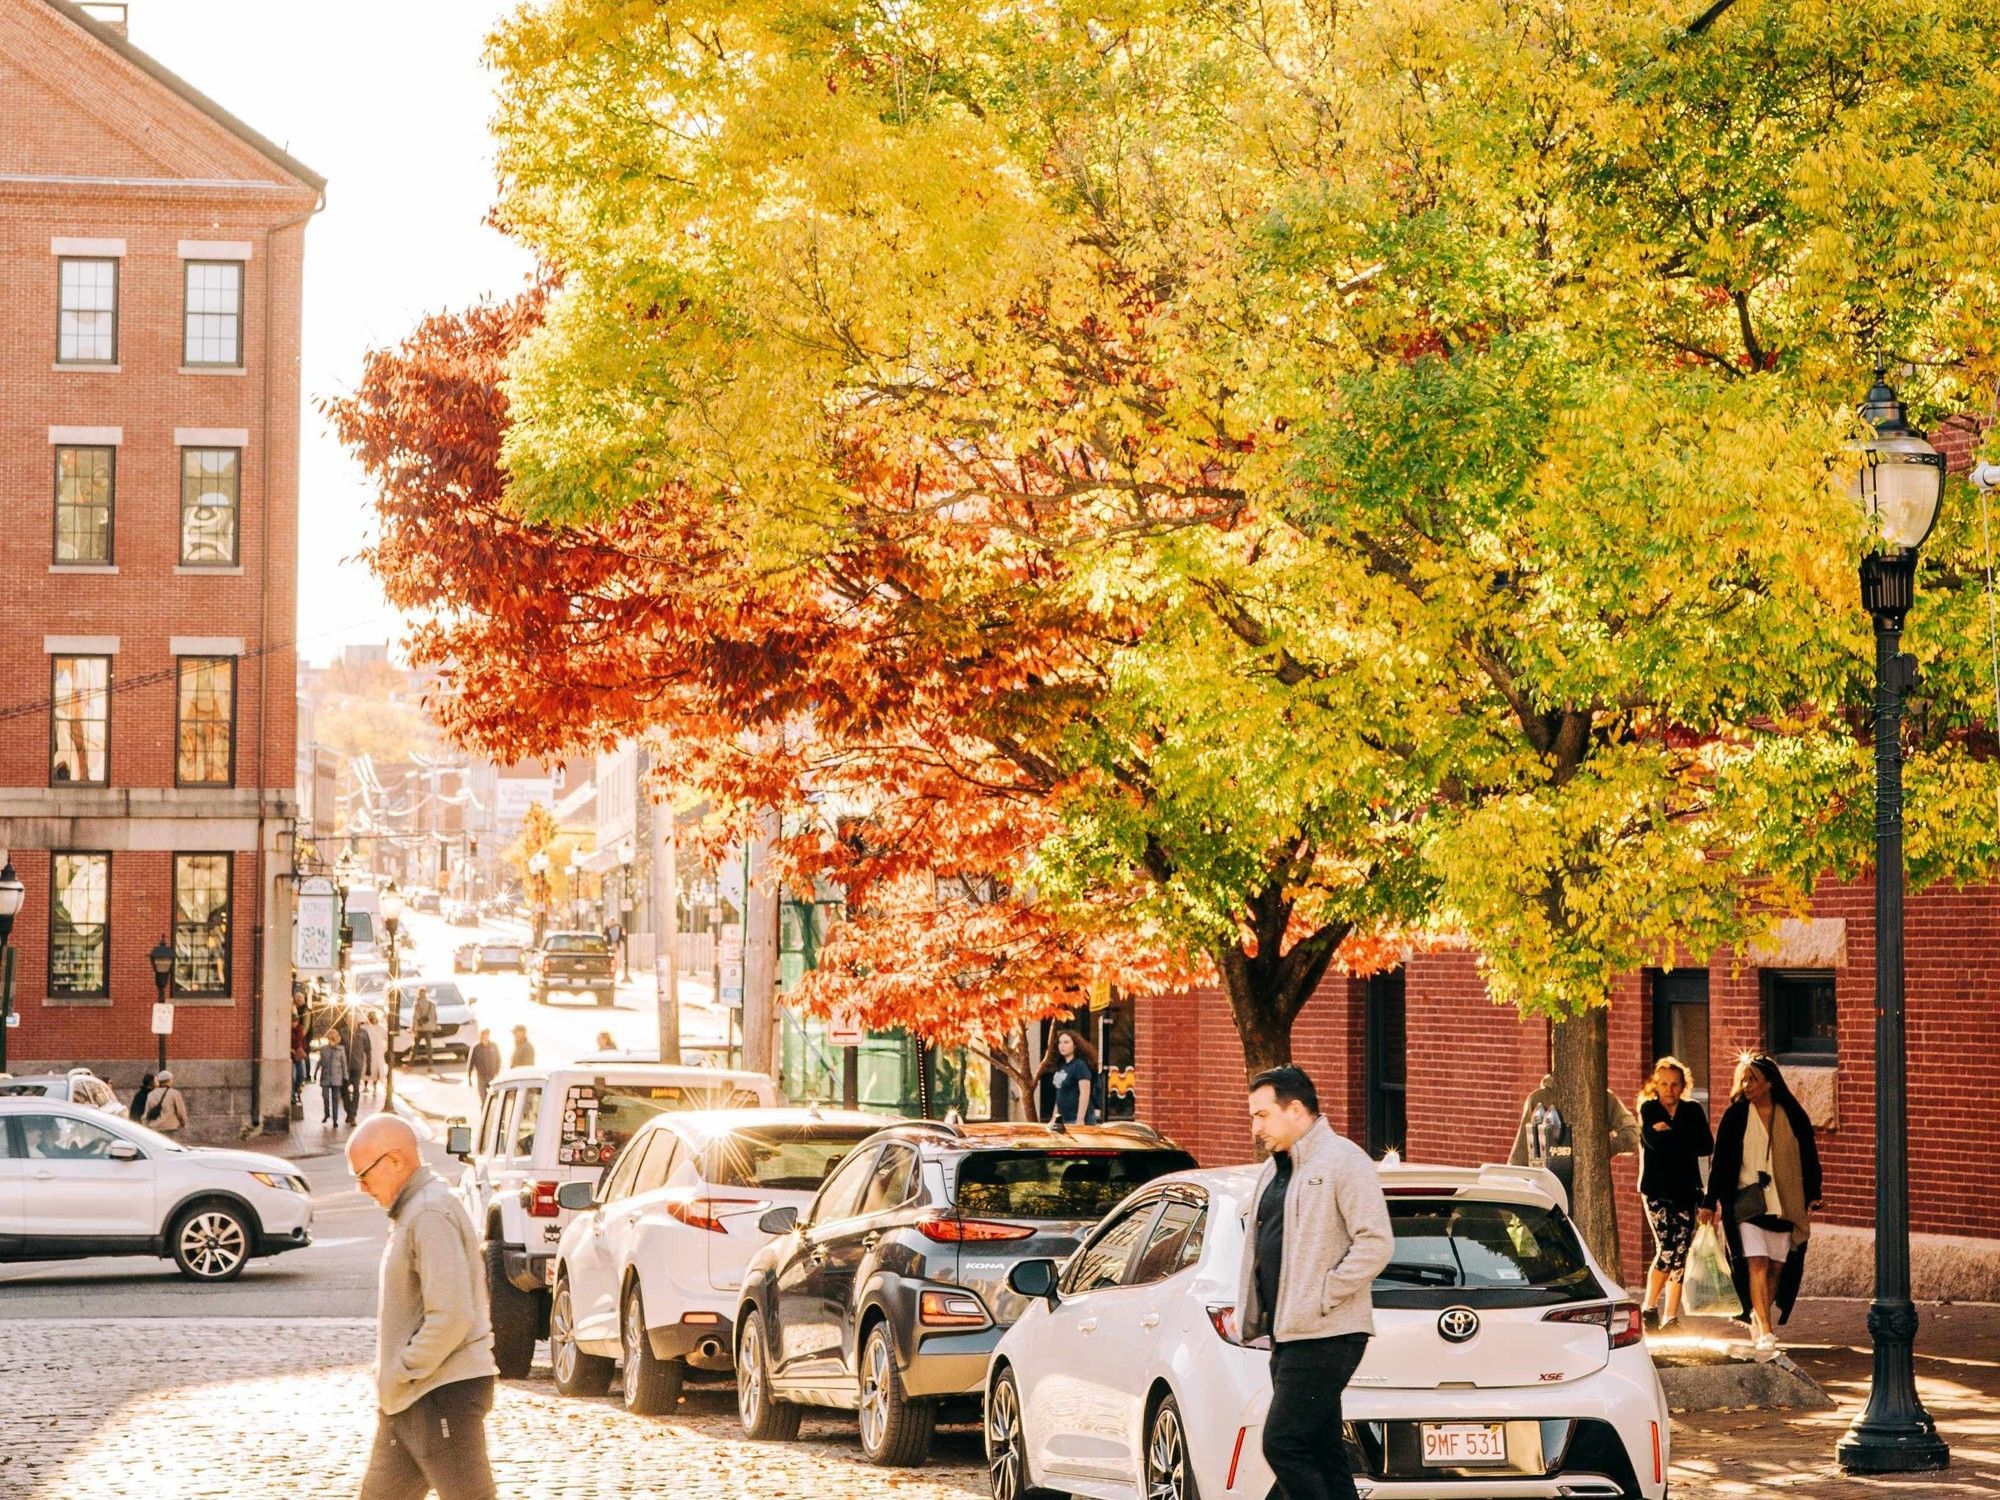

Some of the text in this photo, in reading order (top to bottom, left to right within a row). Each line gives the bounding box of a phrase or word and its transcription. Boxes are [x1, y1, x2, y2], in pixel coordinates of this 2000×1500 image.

[965, 1262, 1005, 1270] KONA
[1539, 1372, 1564, 1381] XSE
[1426, 1433, 1502, 1456] 9MF 531
